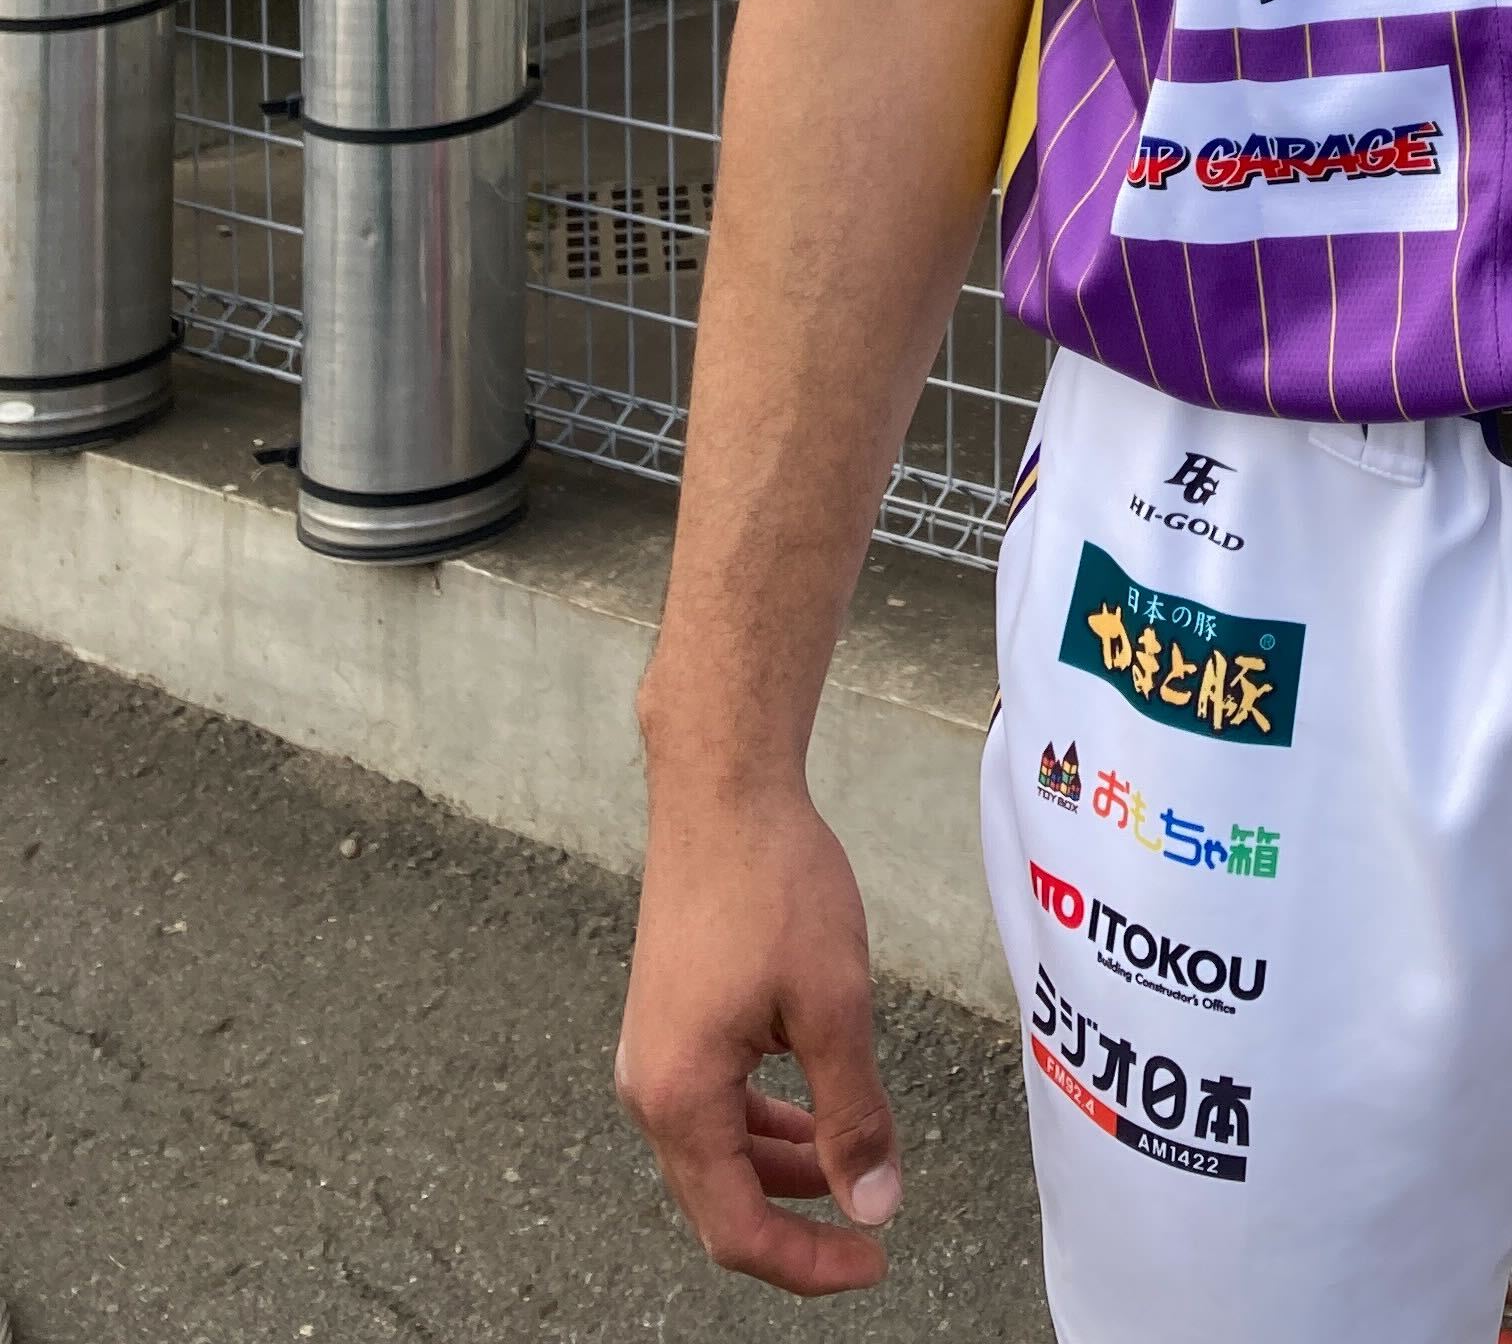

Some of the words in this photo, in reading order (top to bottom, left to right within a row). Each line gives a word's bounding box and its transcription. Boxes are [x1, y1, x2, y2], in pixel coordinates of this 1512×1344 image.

[1195, 120, 1444, 193] GARAGE
[1129, 494, 1245, 552] HI-GOLD
[1127, 586, 1218, 642] 日本の豚
[1087, 602, 1273, 733] やまと豚
[1037, 785, 1057, 804] TOY
[1057, 796, 1079, 814] BOX
[1092, 769, 1281, 879] おもちゃ箱
[1087, 898, 1267, 1002] ITOKOU
[1097, 950, 1133, 983] Building
[1135, 972, 1199, 1007] Constructor's
[1202, 997, 1236, 1015] Office
[1031, 963, 1252, 1147] ラジオ日本
[1045, 1058, 1098, 1117] FM92.4
[1137, 1135, 1221, 1175] AM1422
